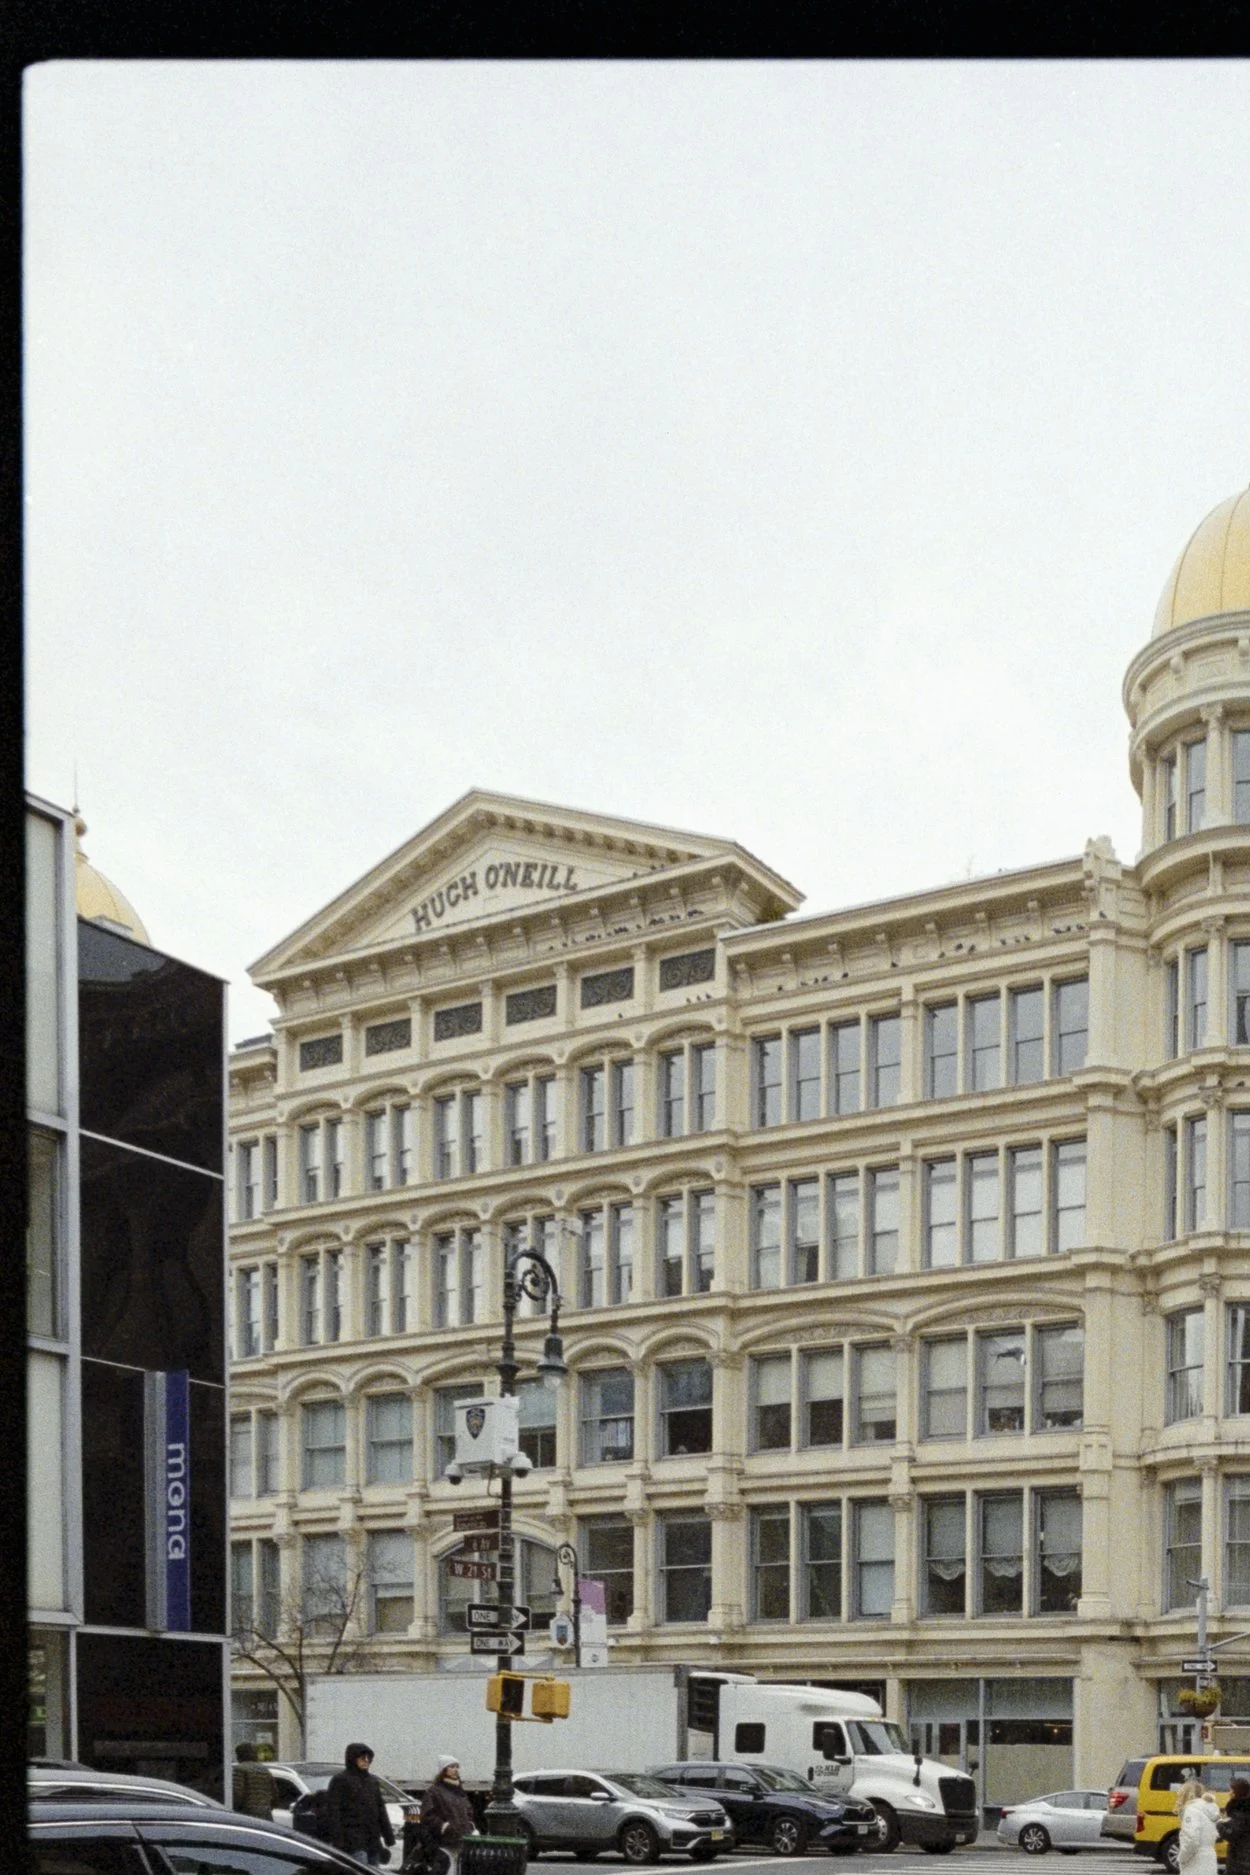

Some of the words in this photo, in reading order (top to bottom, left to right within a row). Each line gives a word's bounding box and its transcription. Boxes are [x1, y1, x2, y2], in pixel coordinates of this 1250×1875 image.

[411, 872, 479, 932] HUGH
[484, 861, 578, 891] O'NEILL
[167, 1443, 185, 1559] mona
[454, 1563, 464, 1576] W
[467, 1564, 477, 1578] 21
[474, 1611, 491, 1621] ONE
[475, 1638, 490, 1648] ONE
[498, 1639, 513, 1649] WAY
